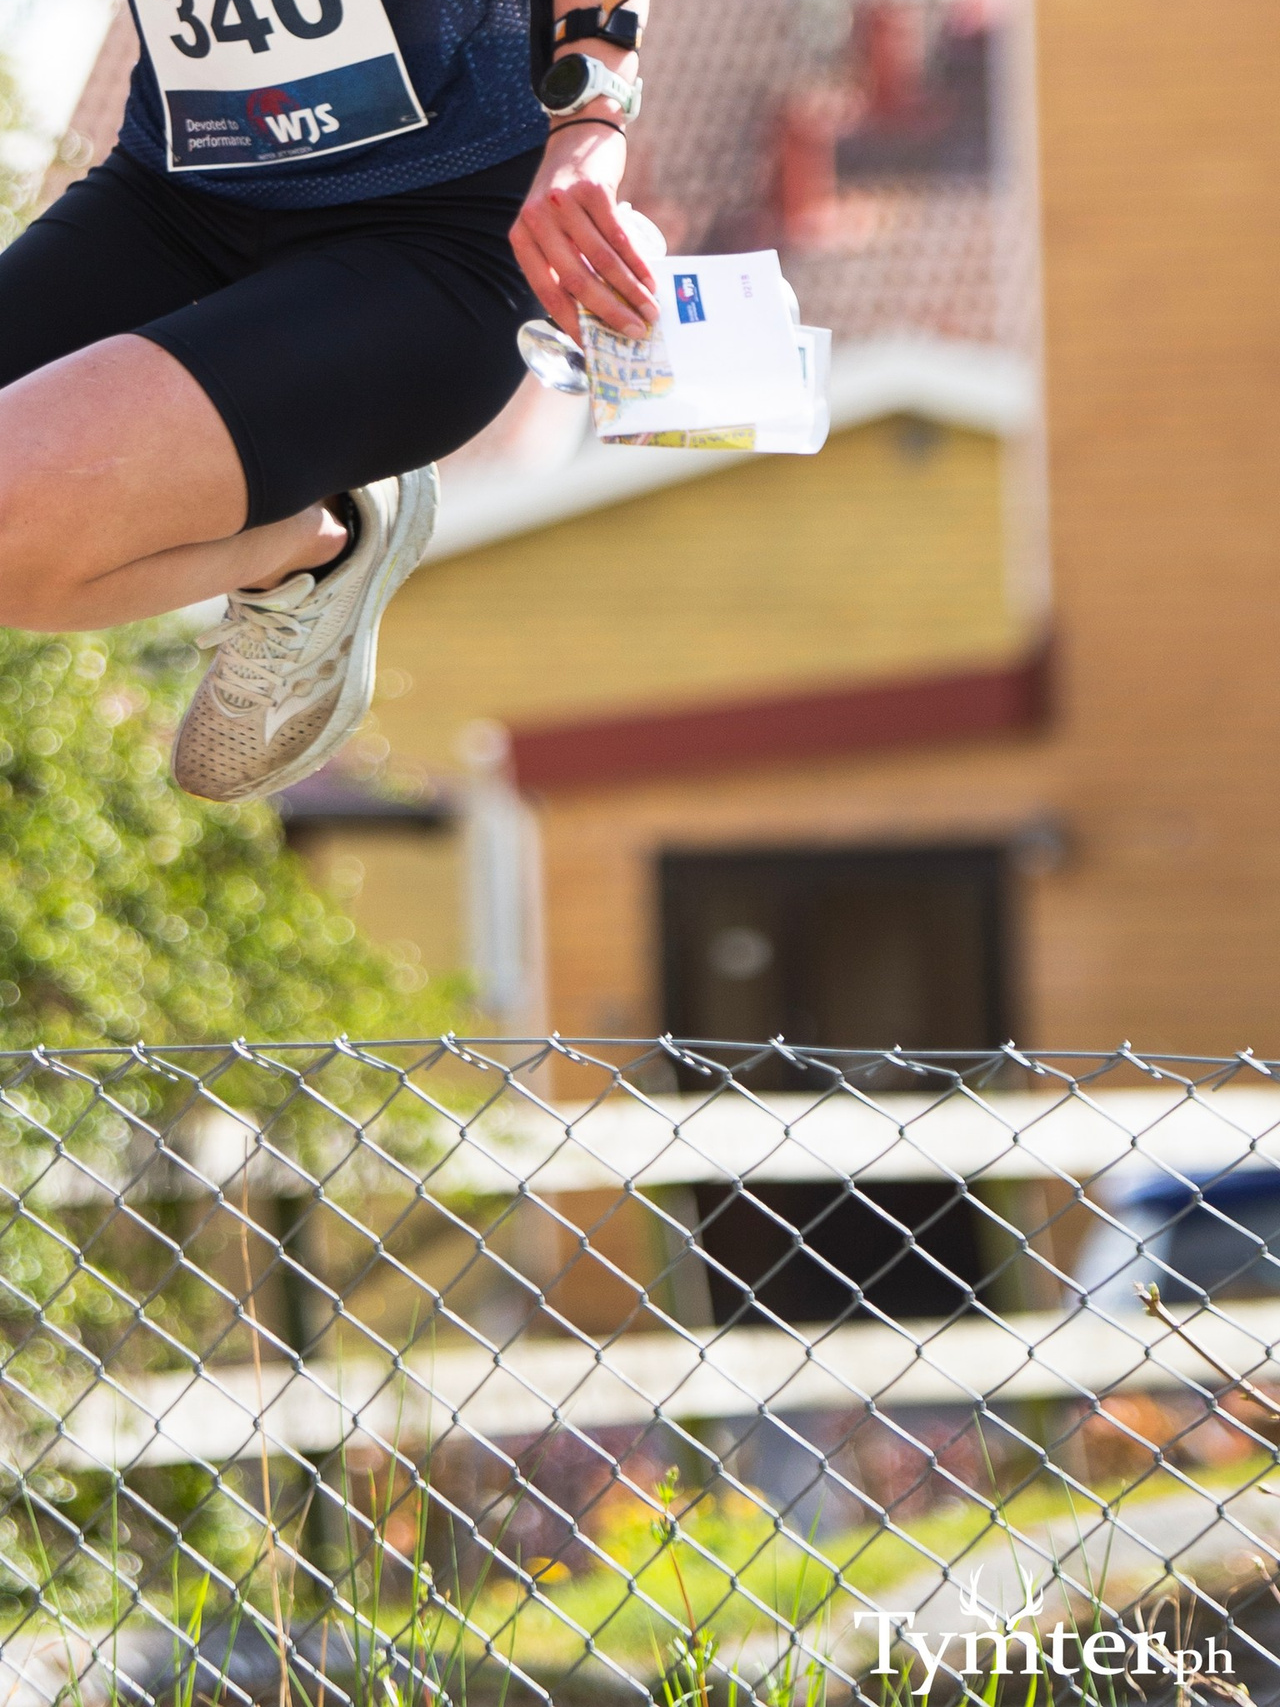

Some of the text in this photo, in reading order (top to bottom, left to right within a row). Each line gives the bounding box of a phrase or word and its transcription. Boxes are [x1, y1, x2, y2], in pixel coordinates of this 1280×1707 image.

[185, 118, 239, 133] Devoted to
[264, 102, 340, 144] WJS
[188, 135, 252, 152] performance
